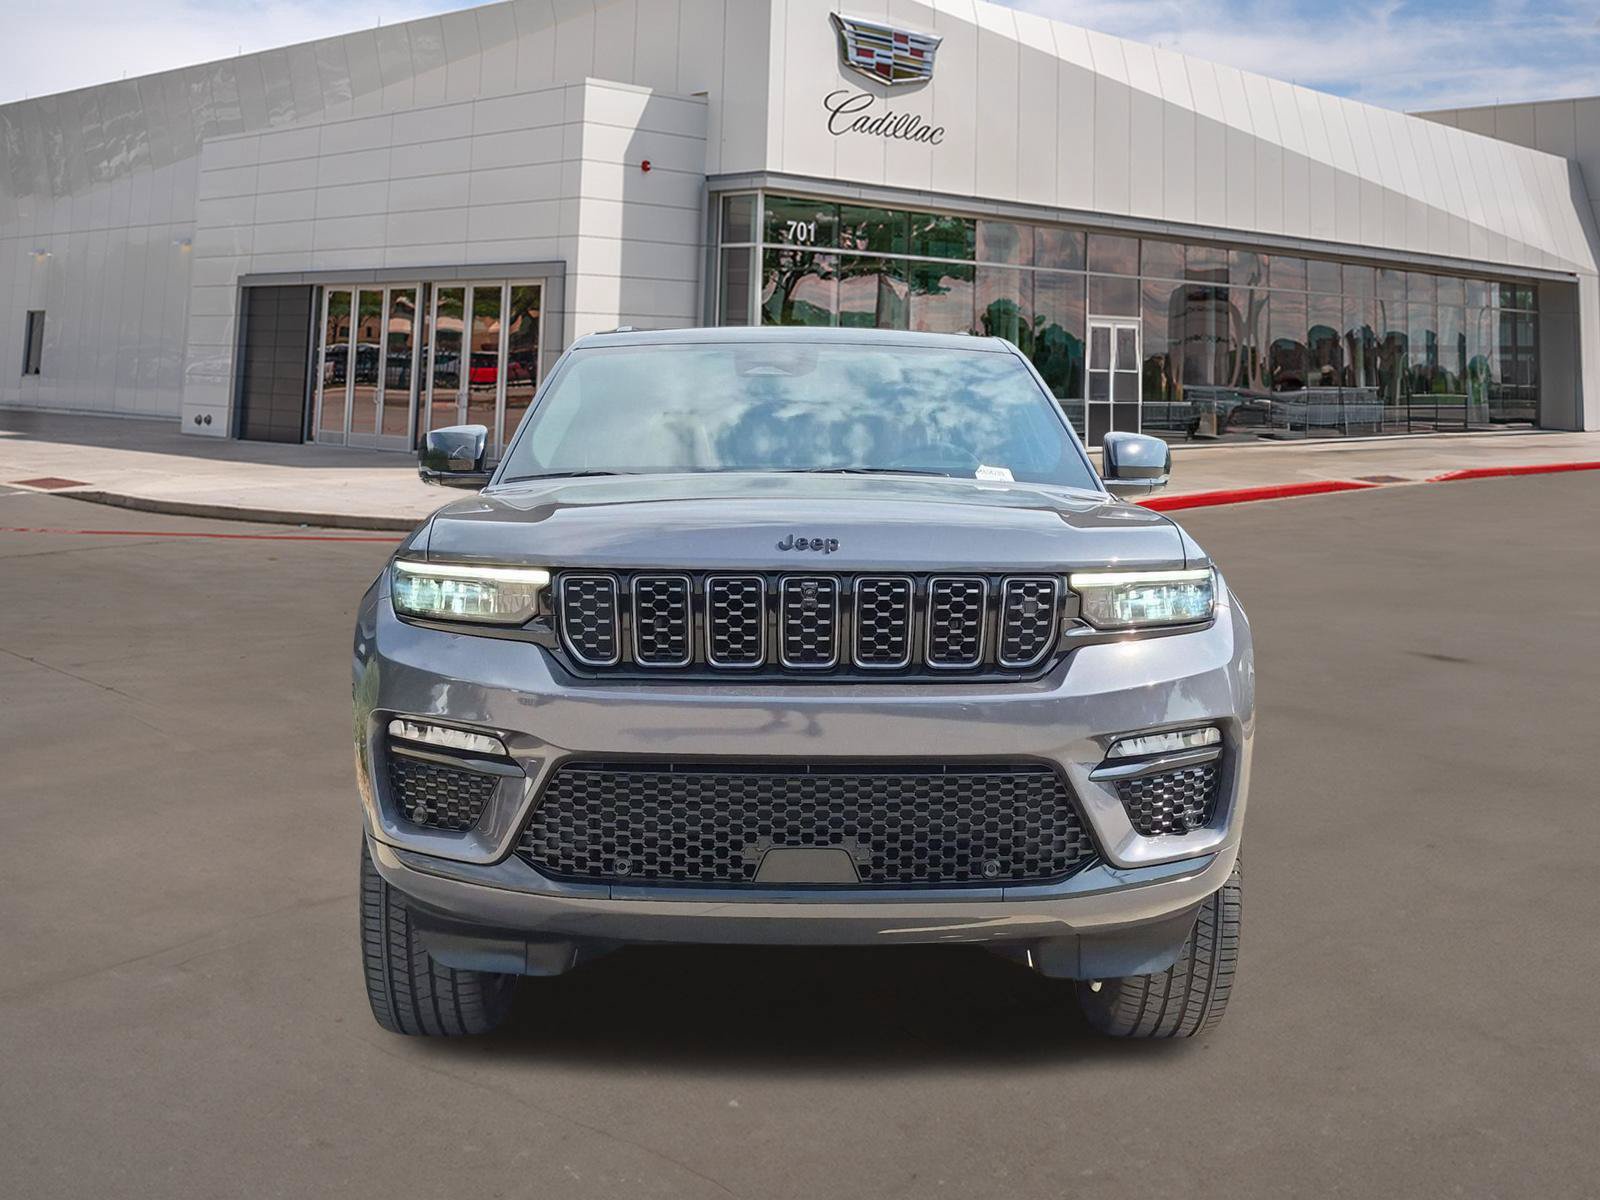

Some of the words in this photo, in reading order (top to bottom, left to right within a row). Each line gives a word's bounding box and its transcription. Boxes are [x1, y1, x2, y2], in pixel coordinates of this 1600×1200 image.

[824, 90, 945, 145] Cadillac
[786, 220, 817, 242] 701
[778, 534, 840, 555] Jeep
